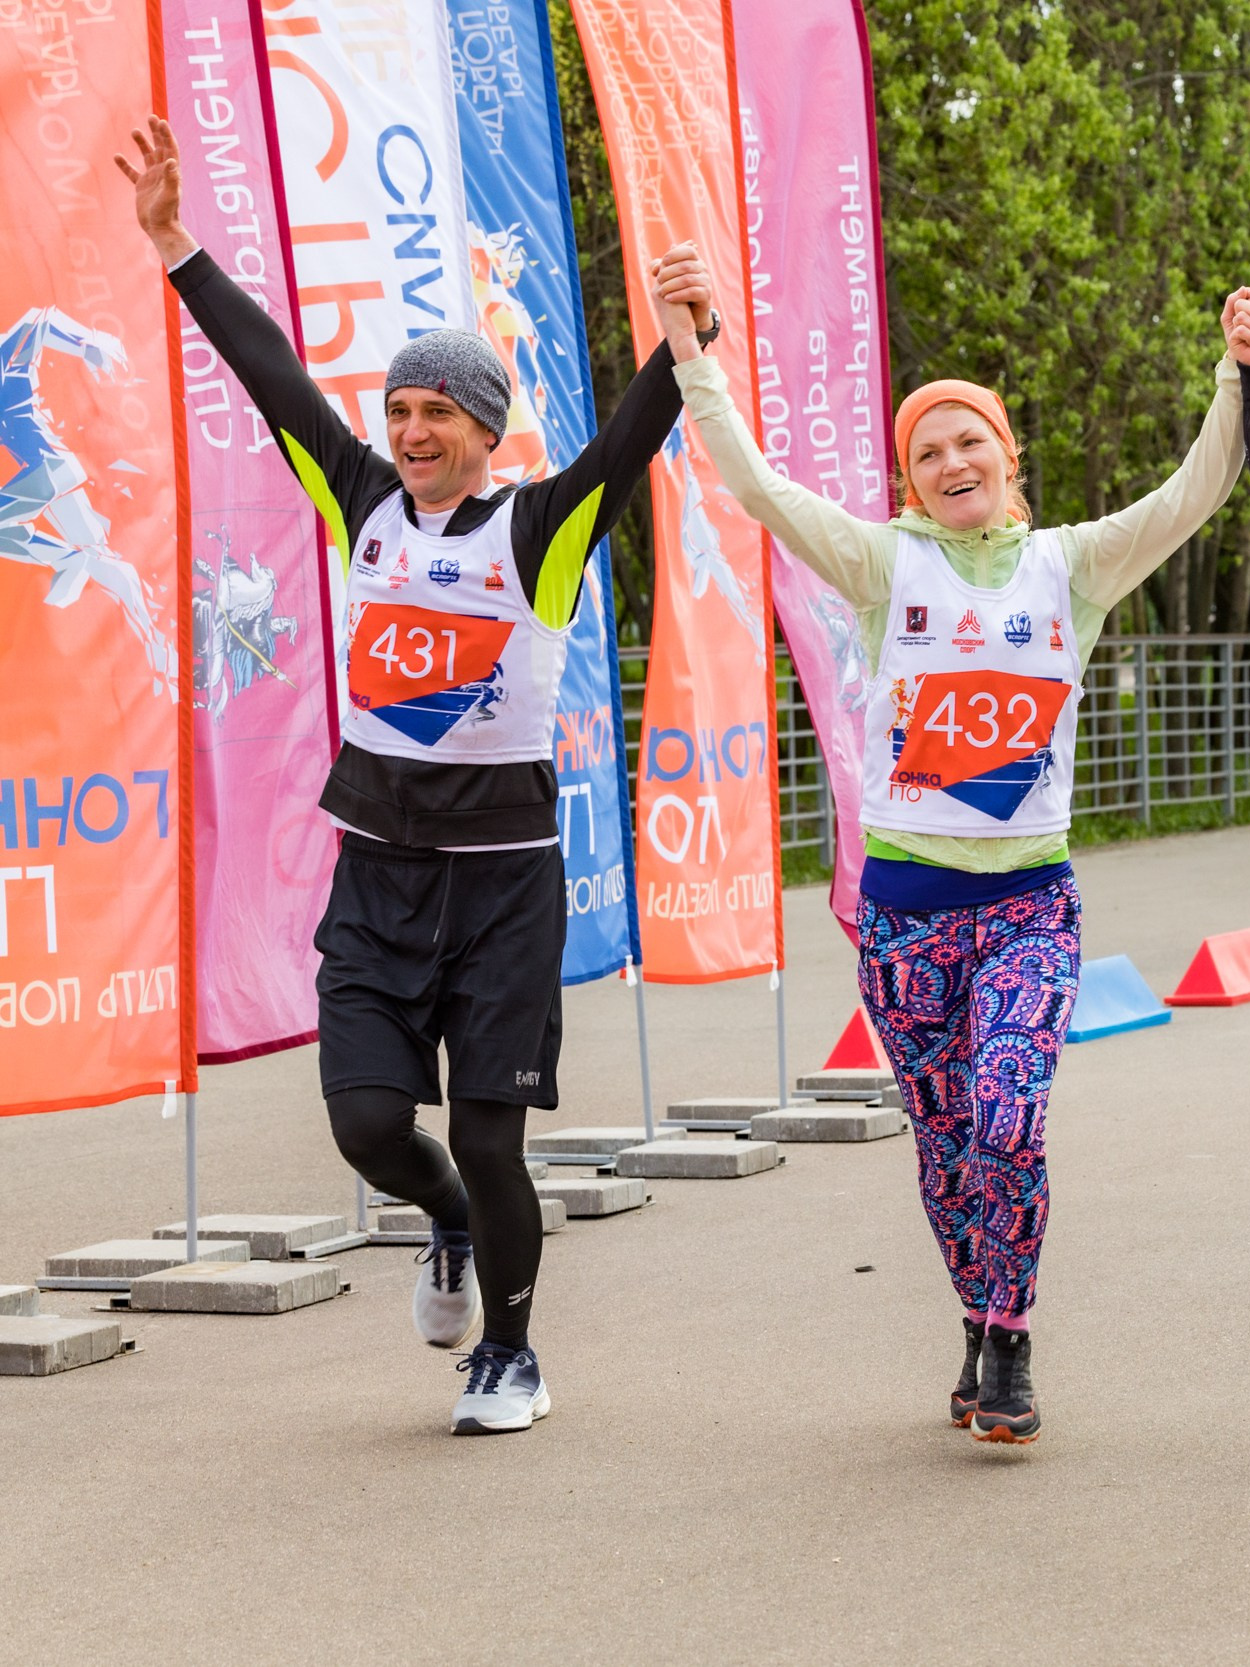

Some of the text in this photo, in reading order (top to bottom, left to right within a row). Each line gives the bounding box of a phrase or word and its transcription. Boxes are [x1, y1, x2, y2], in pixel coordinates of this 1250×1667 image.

[369, 623, 457, 681] 431
[924, 691, 1037, 749] 432
[890, 784, 922, 802] ГТО
